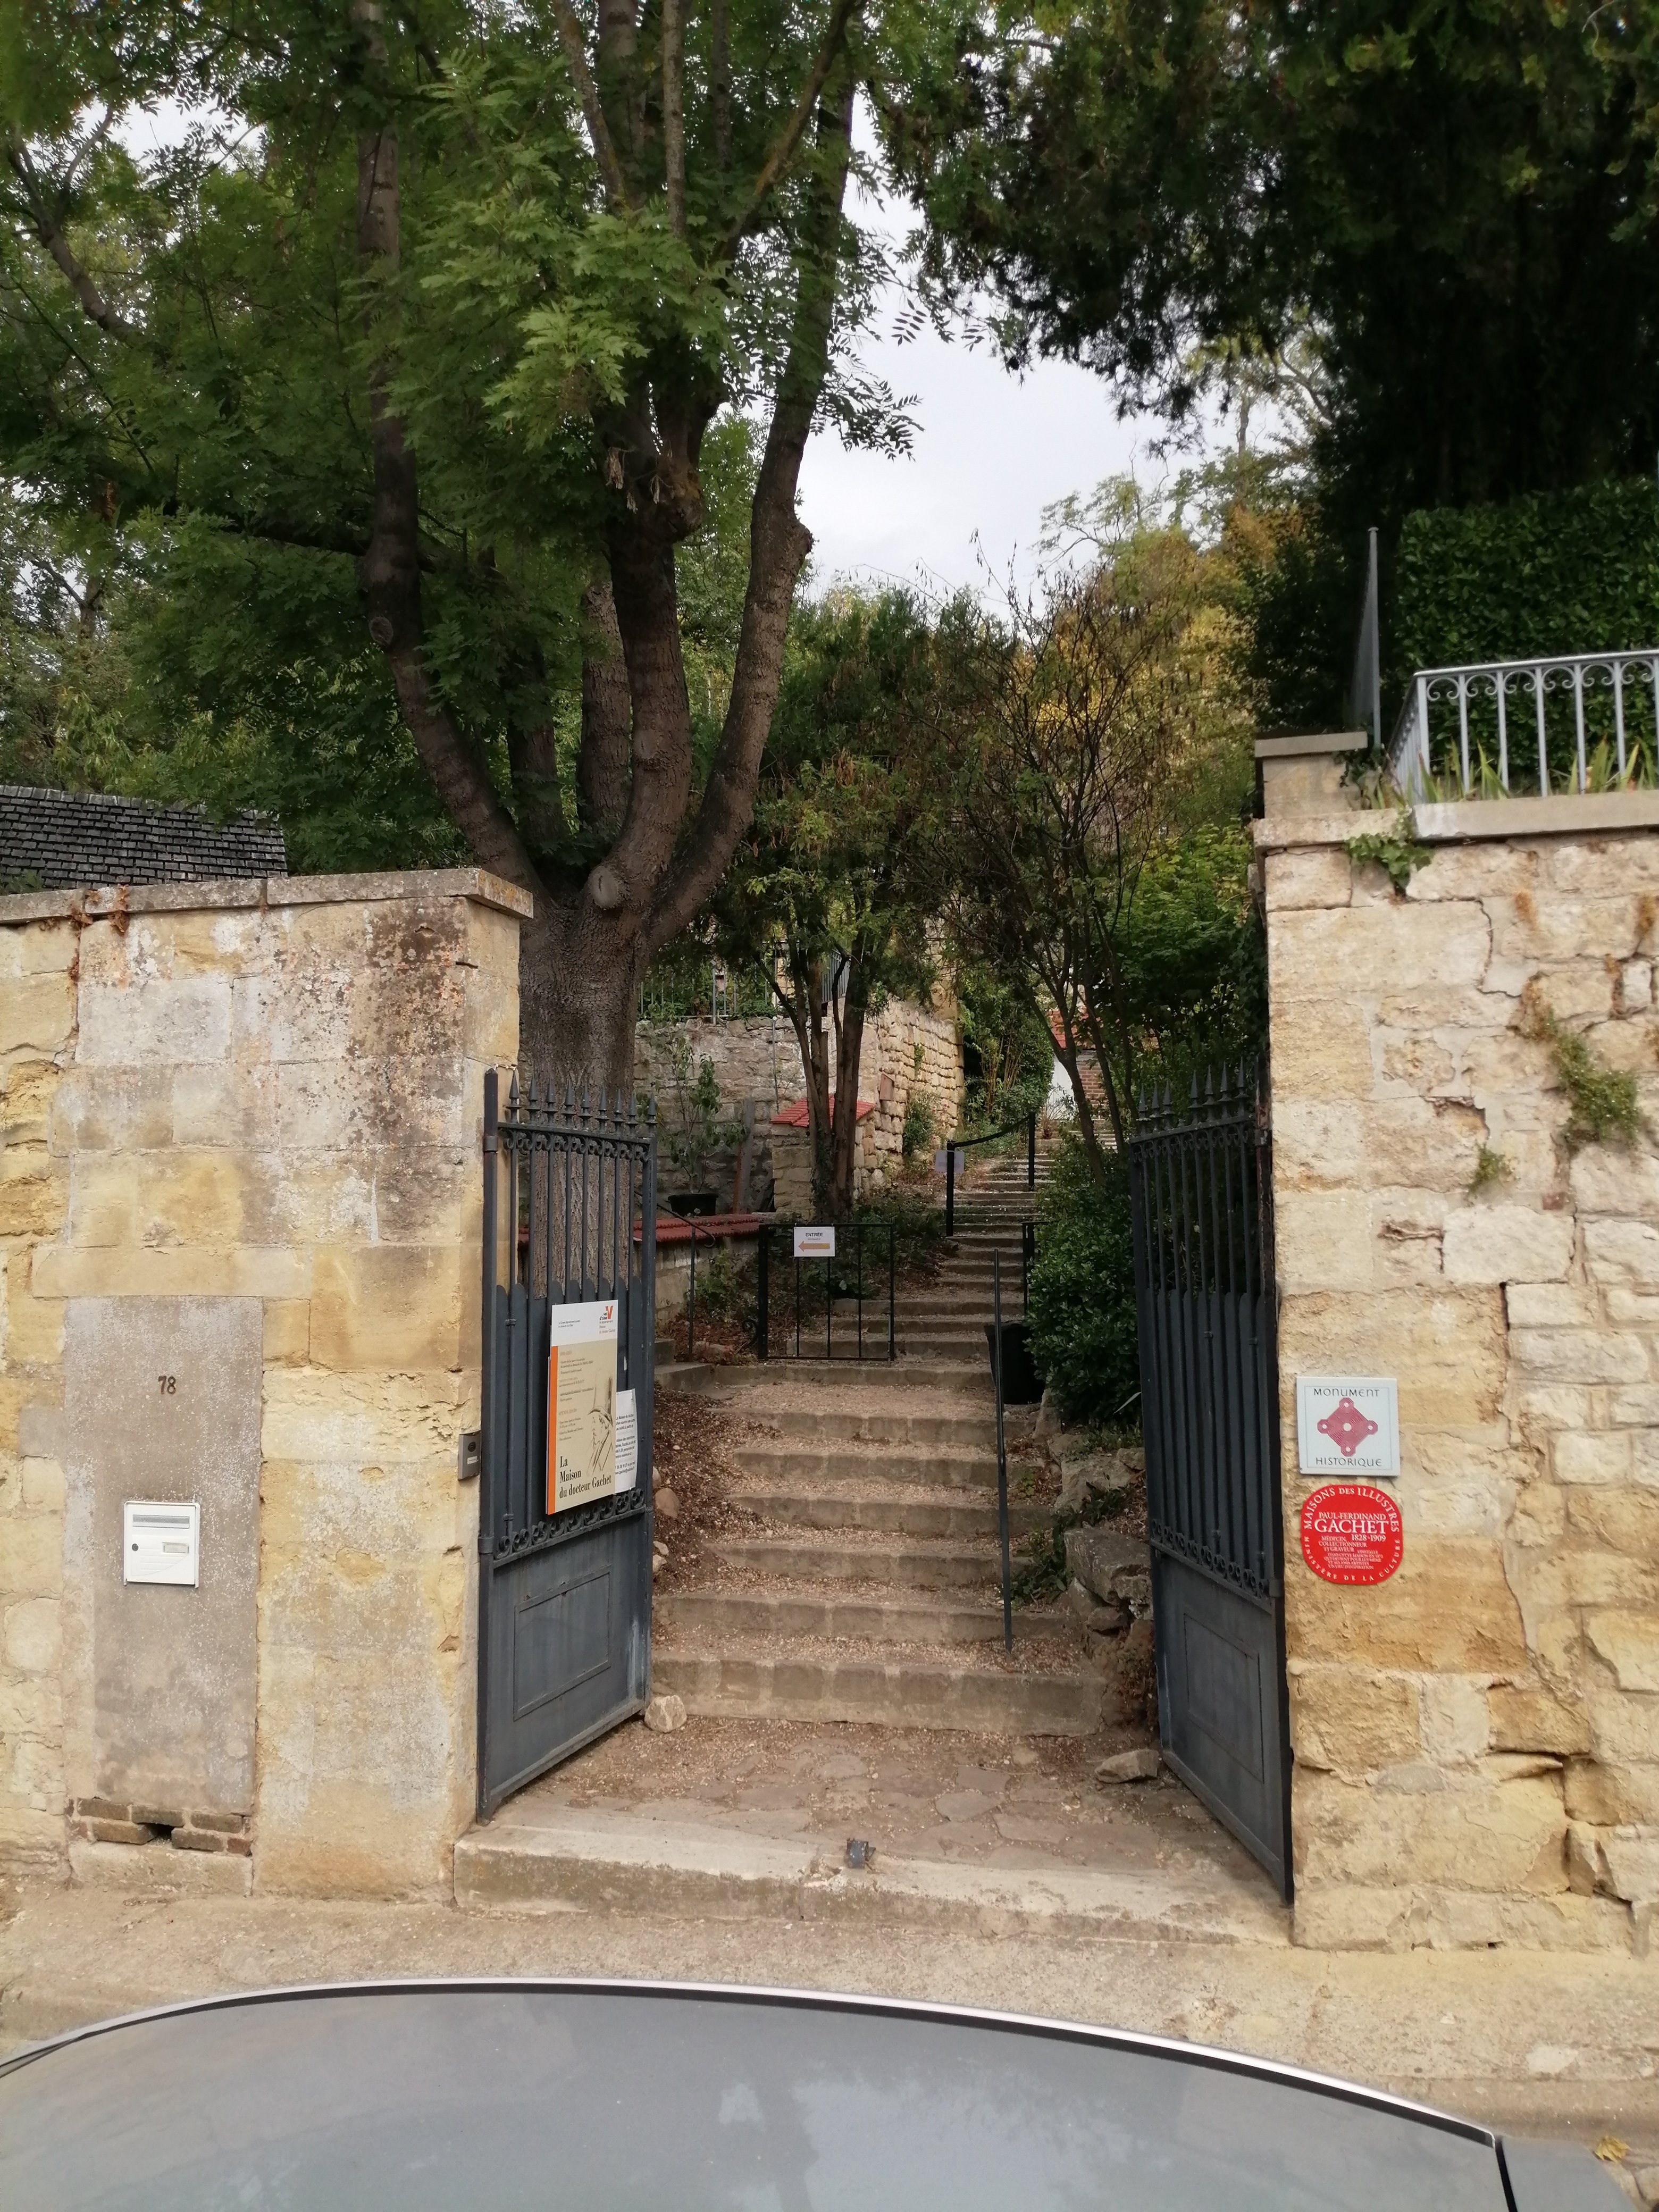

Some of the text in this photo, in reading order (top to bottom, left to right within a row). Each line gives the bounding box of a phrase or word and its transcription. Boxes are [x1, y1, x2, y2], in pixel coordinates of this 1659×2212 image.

[158, 1376, 176, 1394] 78
[1314, 1388, 1380, 1397] MONUMENT
[559, 1456, 568, 1468] La
[1316, 1457, 1382, 1467] HISTORIQUE
[559, 1469, 581, 1483] Maison
[559, 1474, 611, 1498] du docteur Gachet
[1304, 1488, 1335, 1529] MAISONS
[1358, 1487, 1400, 1532] ILLUSTRES
[1319, 1512, 1386, 1520] PAUL-FERDINAND
[1314, 1519, 1389, 1534] GACHET
[1304, 1536, 1337, 1580] MINISTÈRE
[1379, 1539, 1400, 1578] CULTURE
